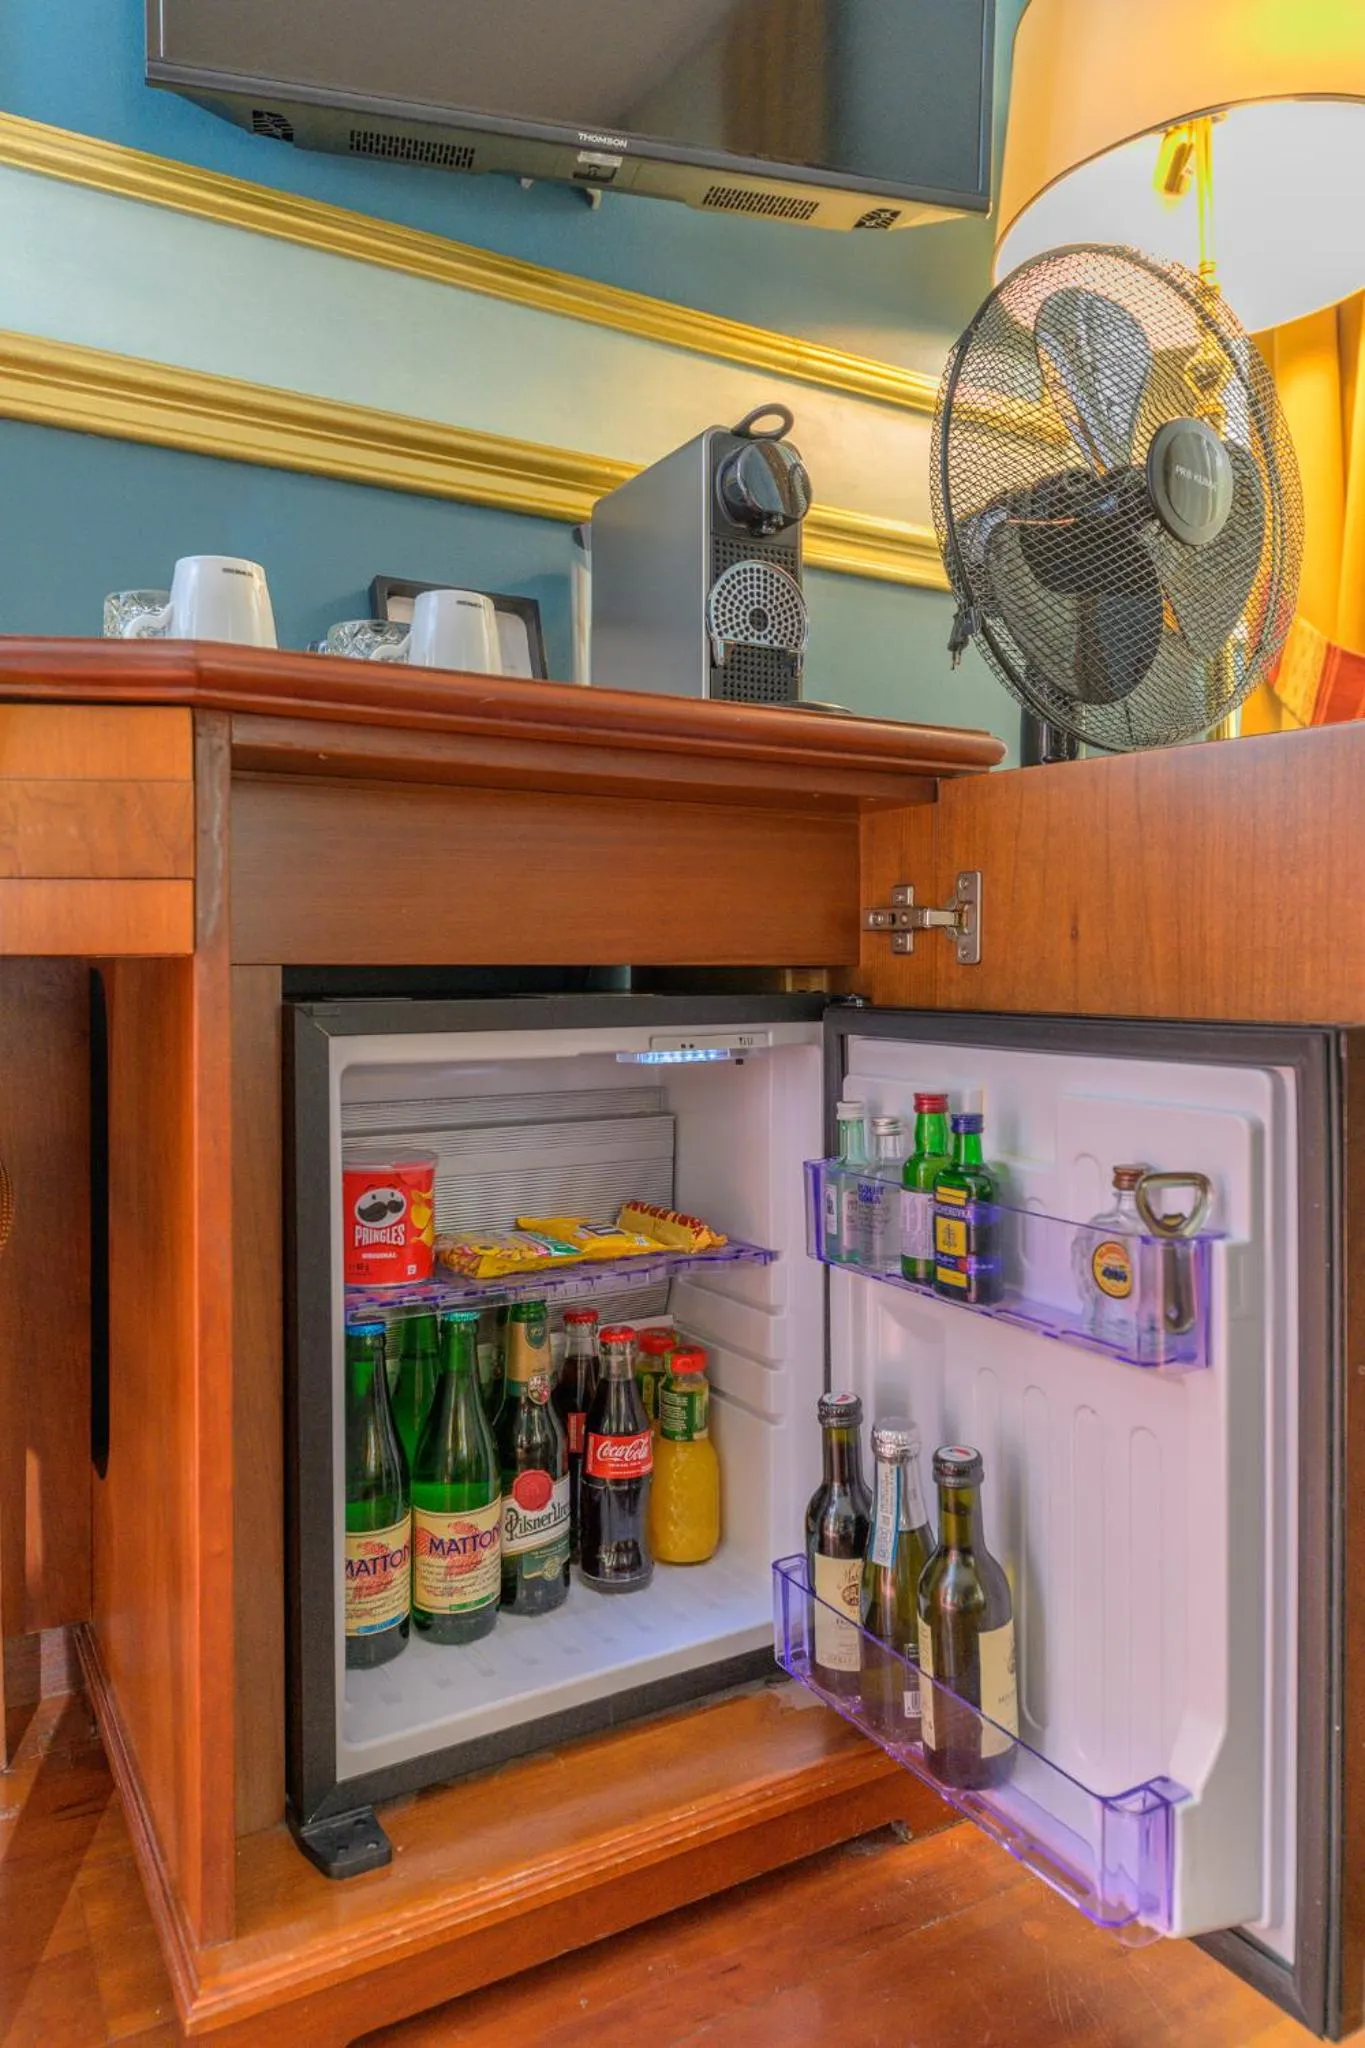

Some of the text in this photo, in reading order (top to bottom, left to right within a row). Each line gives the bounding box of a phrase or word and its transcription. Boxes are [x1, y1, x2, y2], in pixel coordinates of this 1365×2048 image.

[578, 132, 628, 148] THOMSON
[354, 1223, 406, 1247] PRINGLES
[504, 1507, 553, 1541] Pilsner
